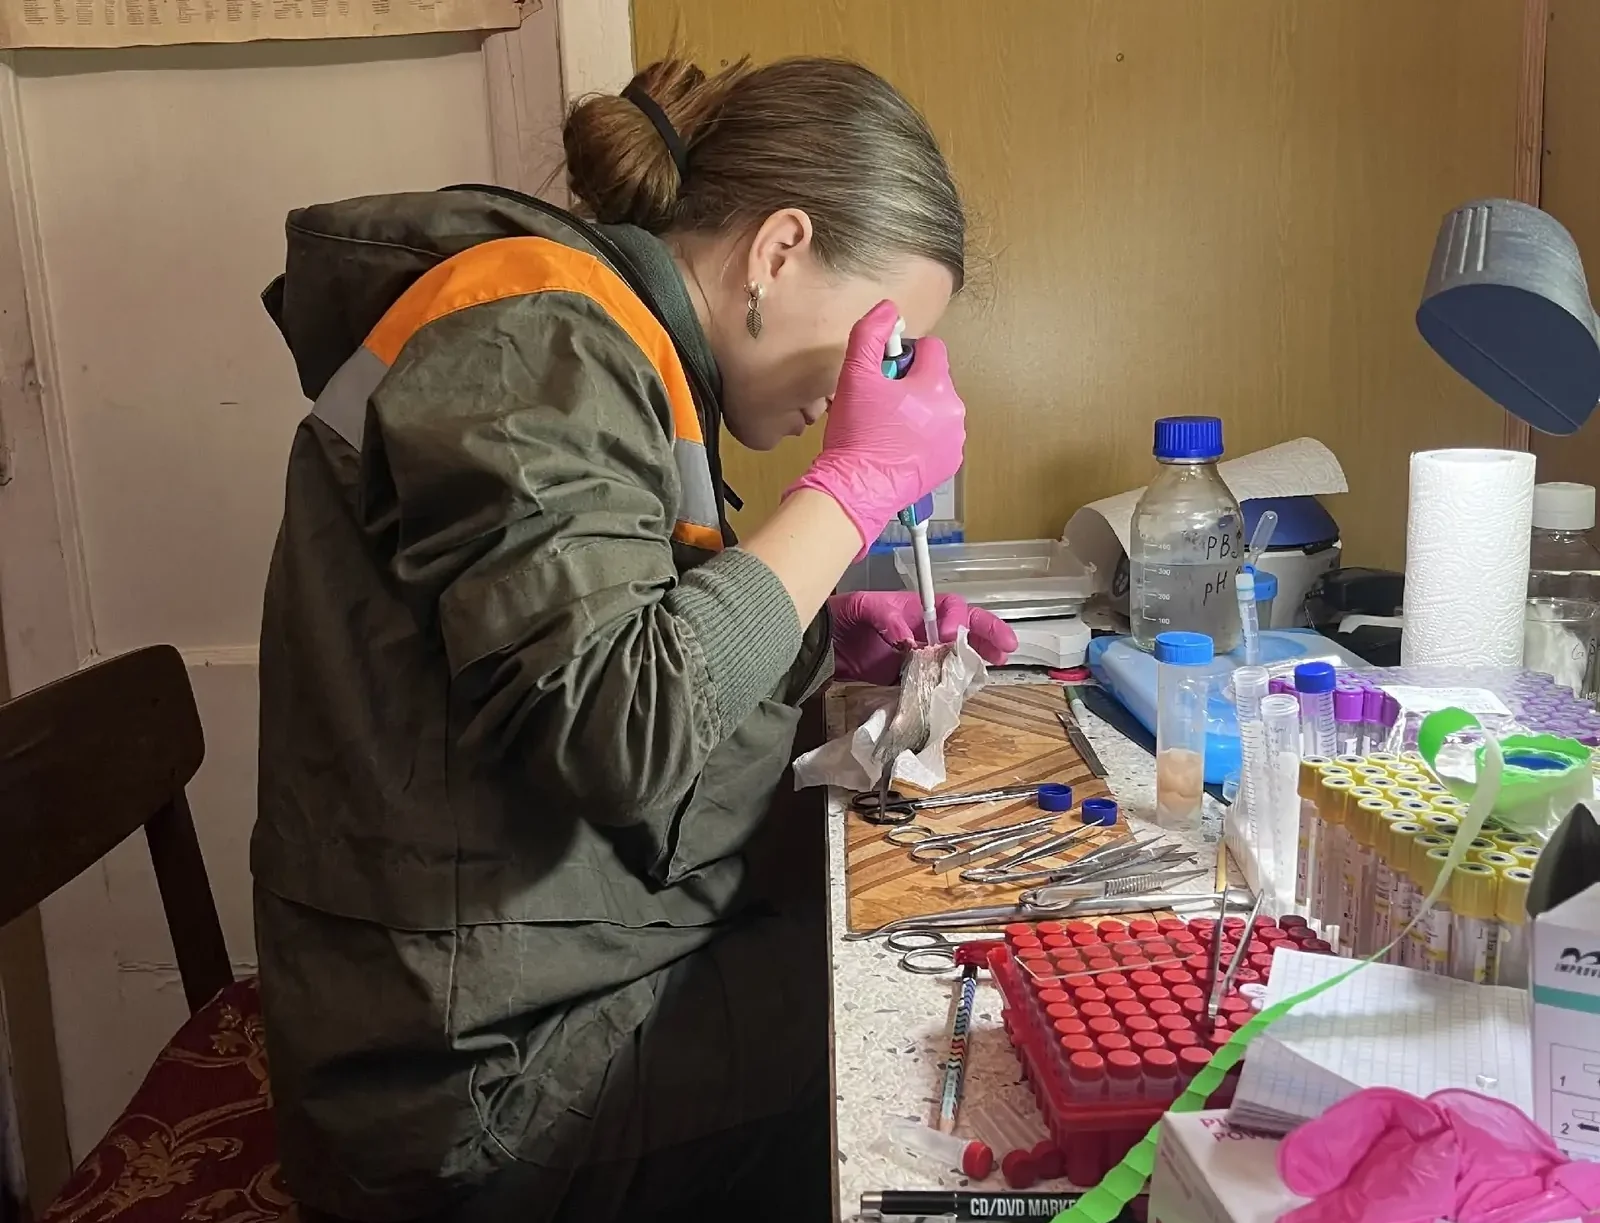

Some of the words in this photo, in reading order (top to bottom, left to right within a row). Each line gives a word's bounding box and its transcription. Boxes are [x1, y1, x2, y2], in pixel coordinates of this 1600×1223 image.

[1158, 568, 1171, 576] 300
[1158, 617, 1171, 625] 100
[1560, 1075, 1566, 1087] 1
[1560, 1122, 1570, 1135] 2
[970, 1198, 1025, 1216] CD/DVD
